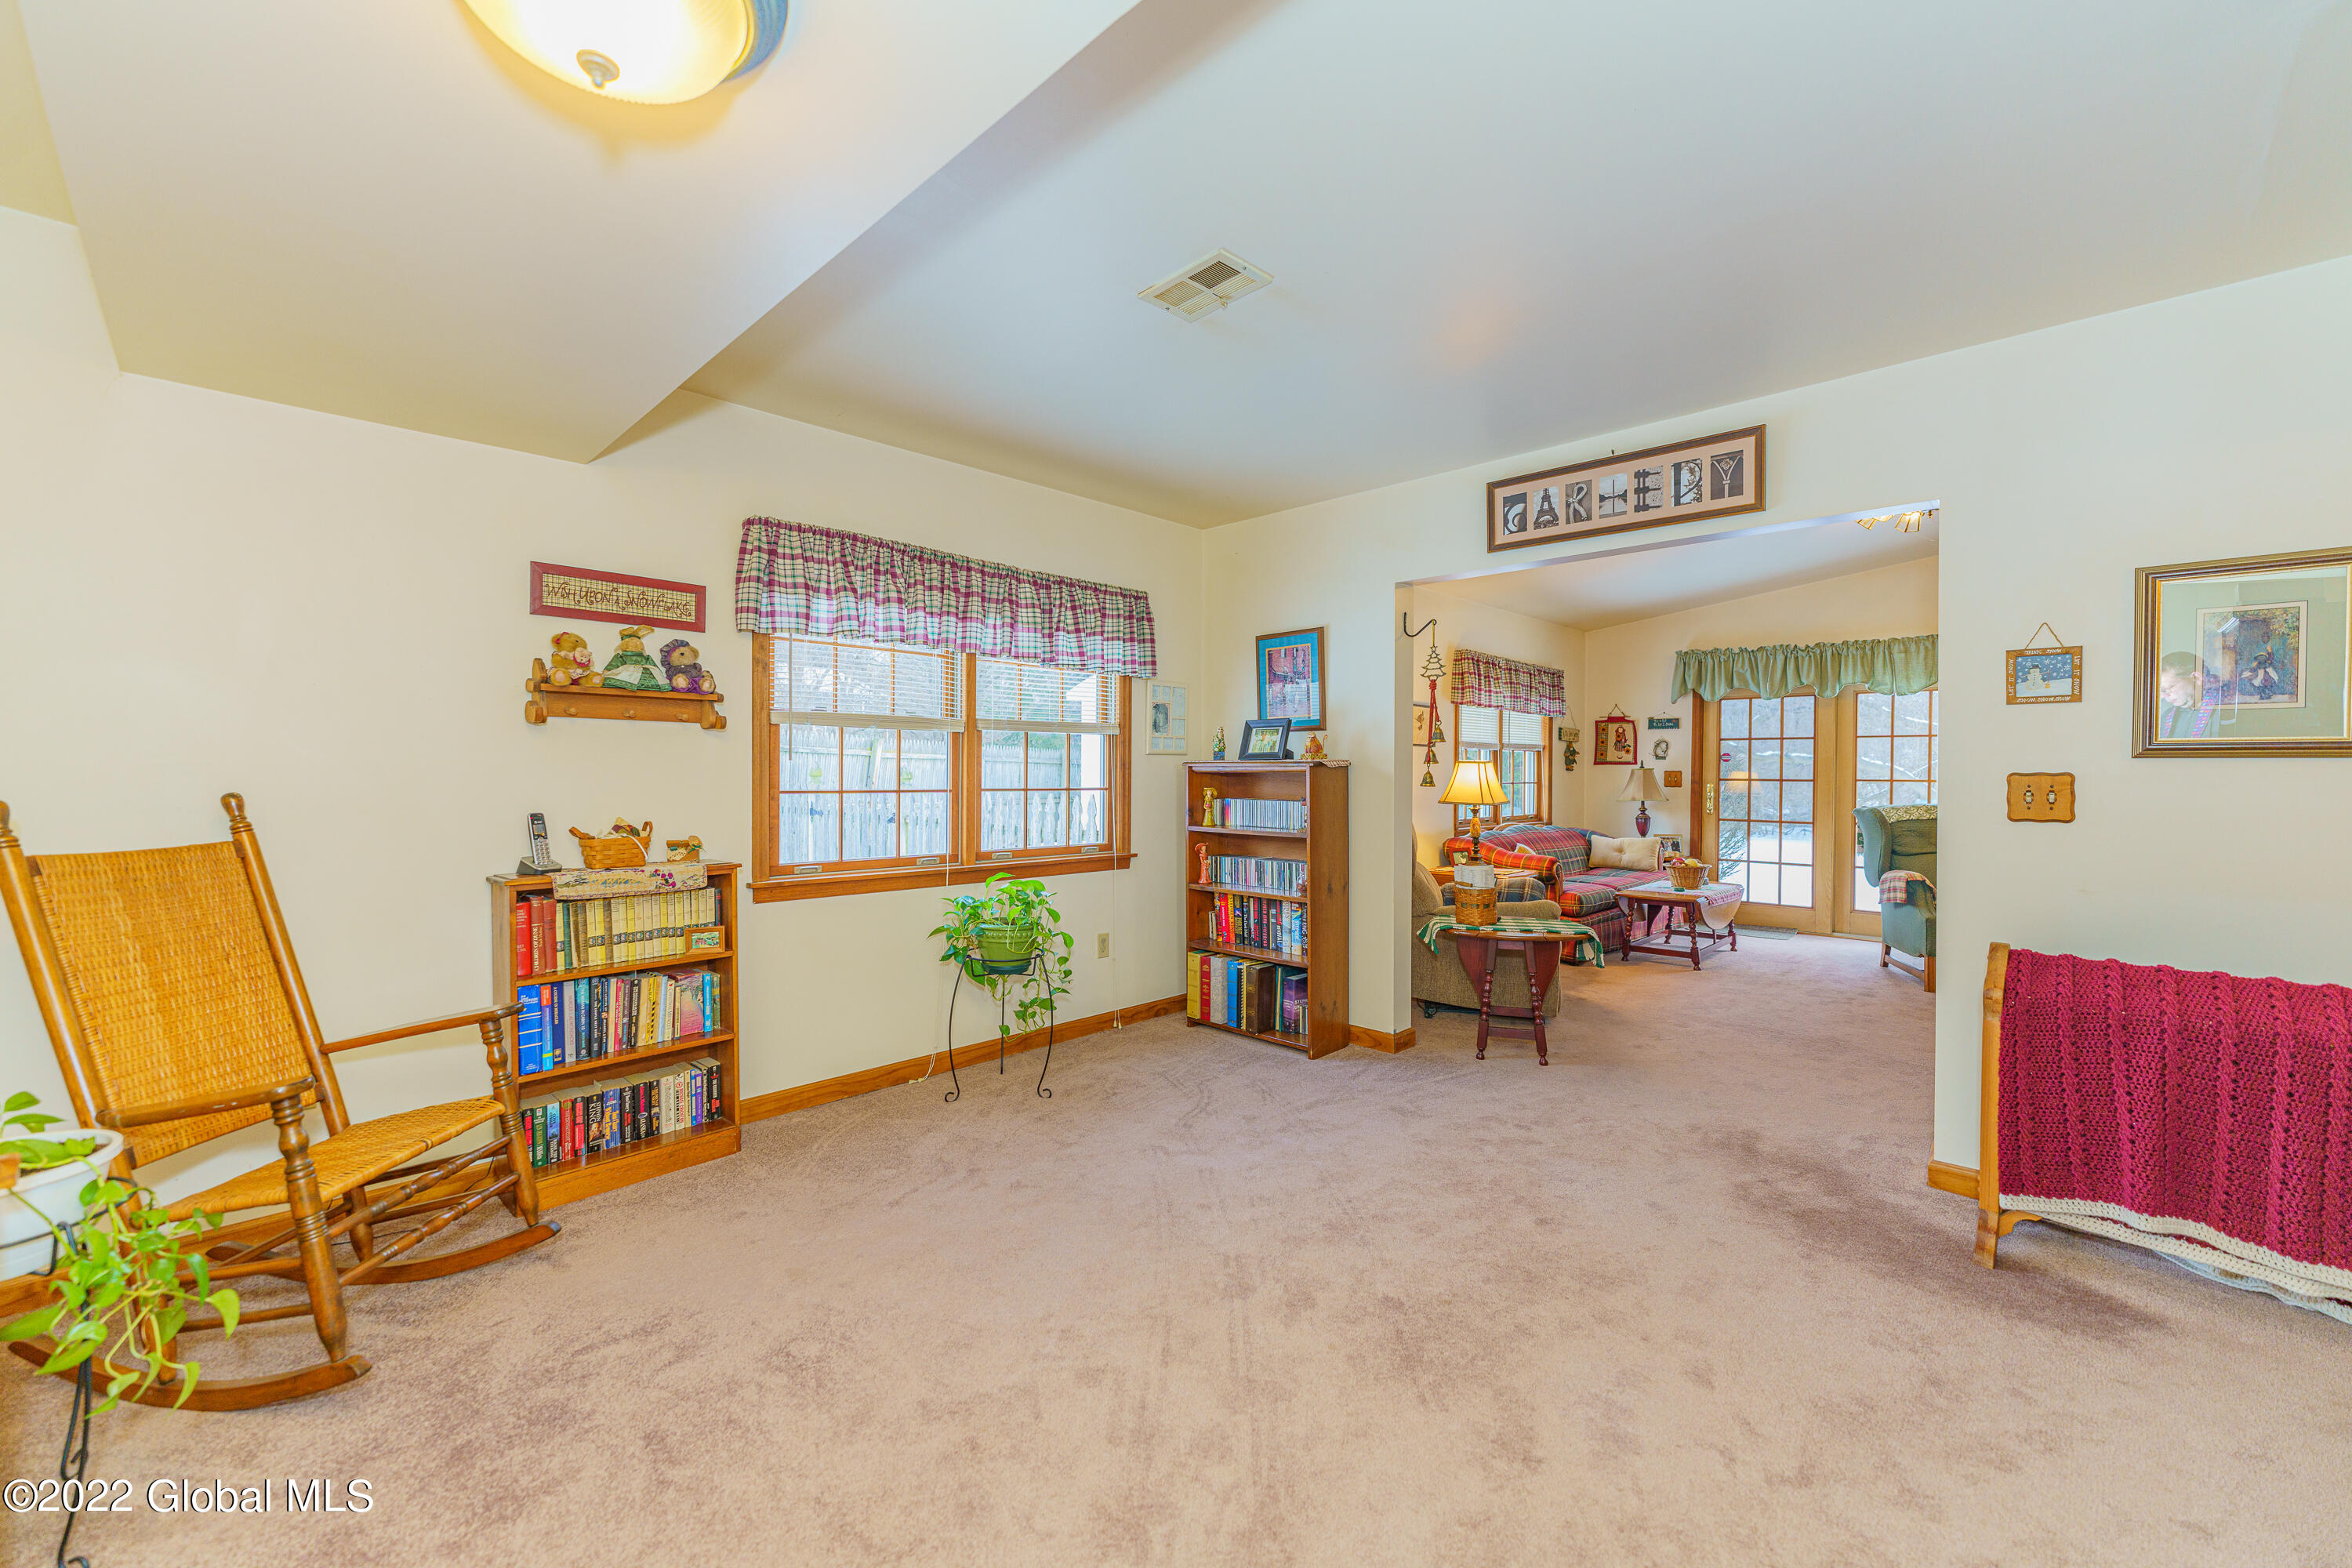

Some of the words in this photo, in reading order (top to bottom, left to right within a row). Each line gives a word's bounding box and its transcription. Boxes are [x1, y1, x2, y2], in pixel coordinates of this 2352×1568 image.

[545, 582, 580, 604] WISH
[580, 586, 618, 605] UPON
[624, 590, 691, 617] SNOWFLAKE
